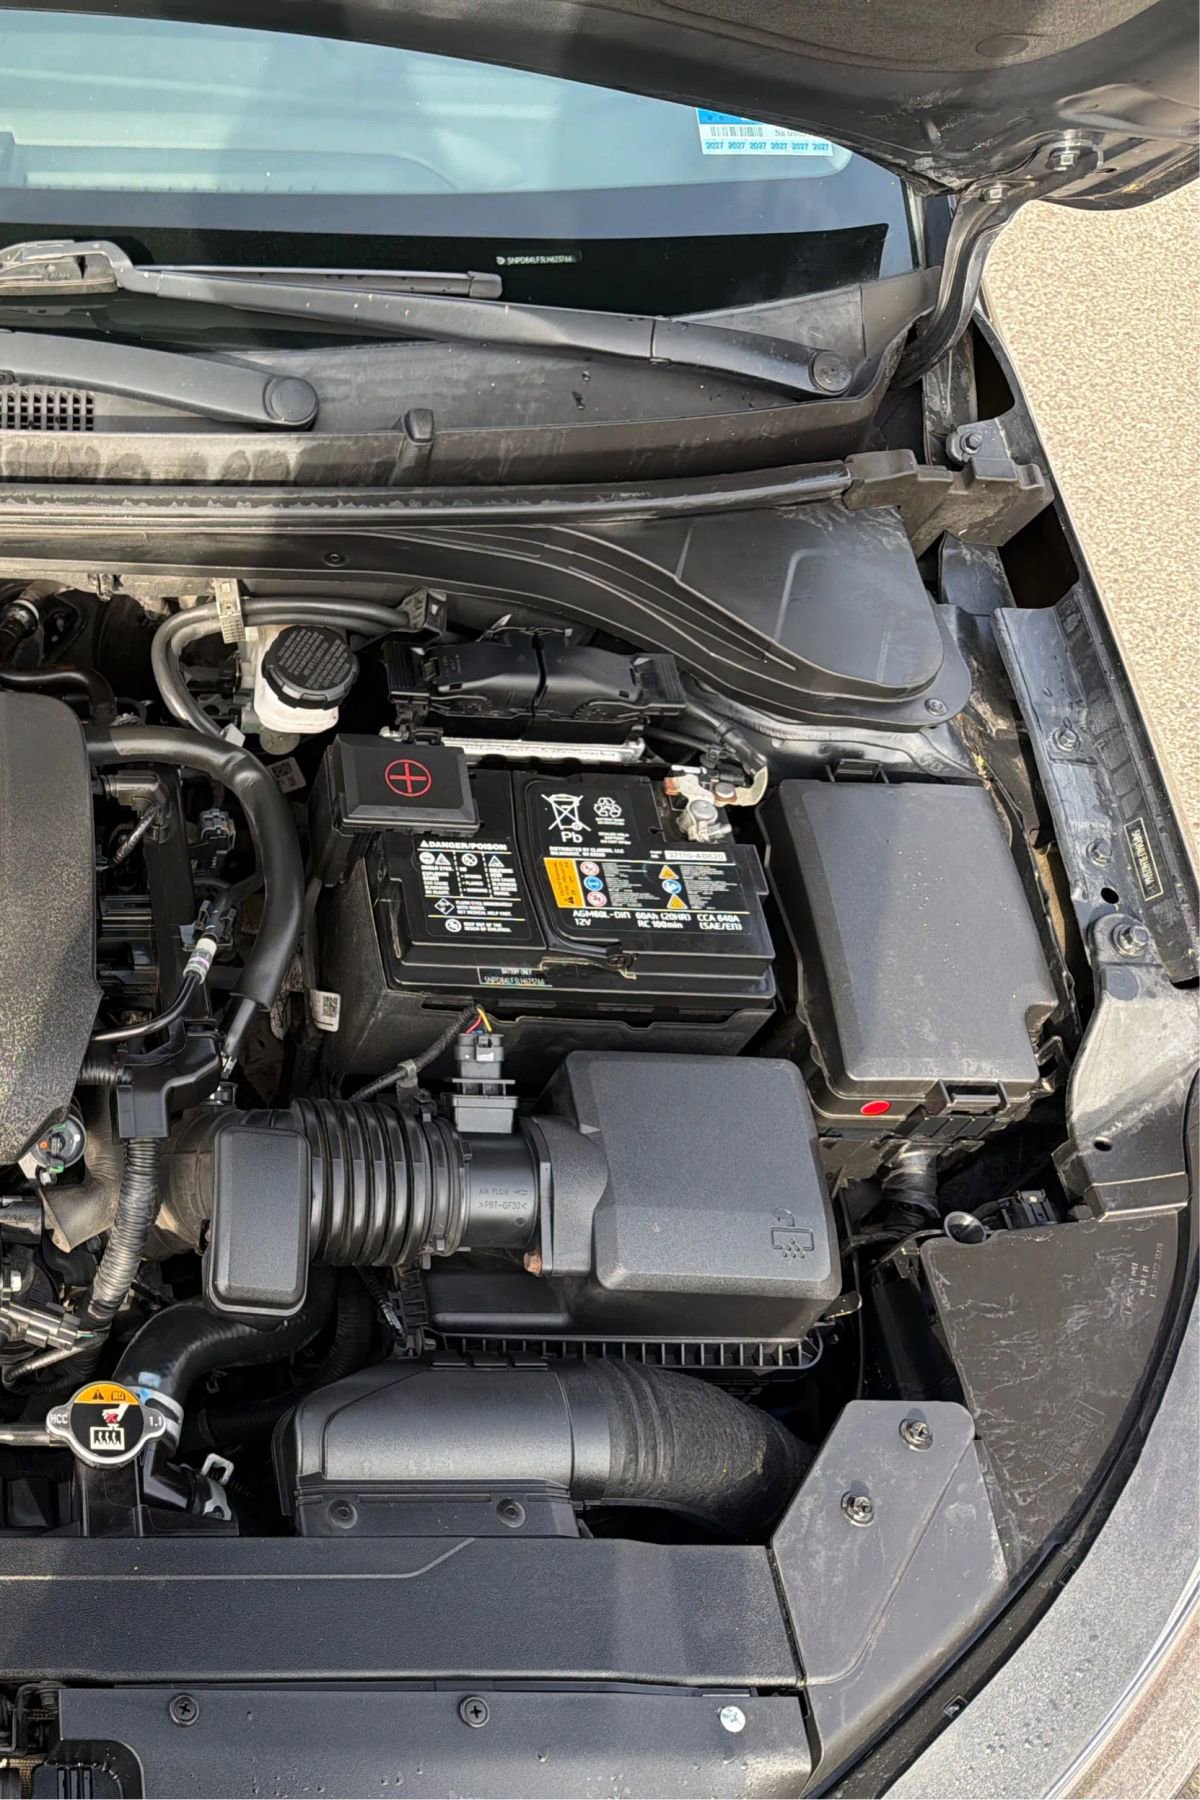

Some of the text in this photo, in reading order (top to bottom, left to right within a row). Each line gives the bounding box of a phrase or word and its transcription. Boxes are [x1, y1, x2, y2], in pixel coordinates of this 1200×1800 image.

[706, 141, 829, 150] 2027 2027 2027 2027 2027 2027
[561, 832, 583, 842] Pb
[50, 1414, 162, 1427] HCC 1.1
